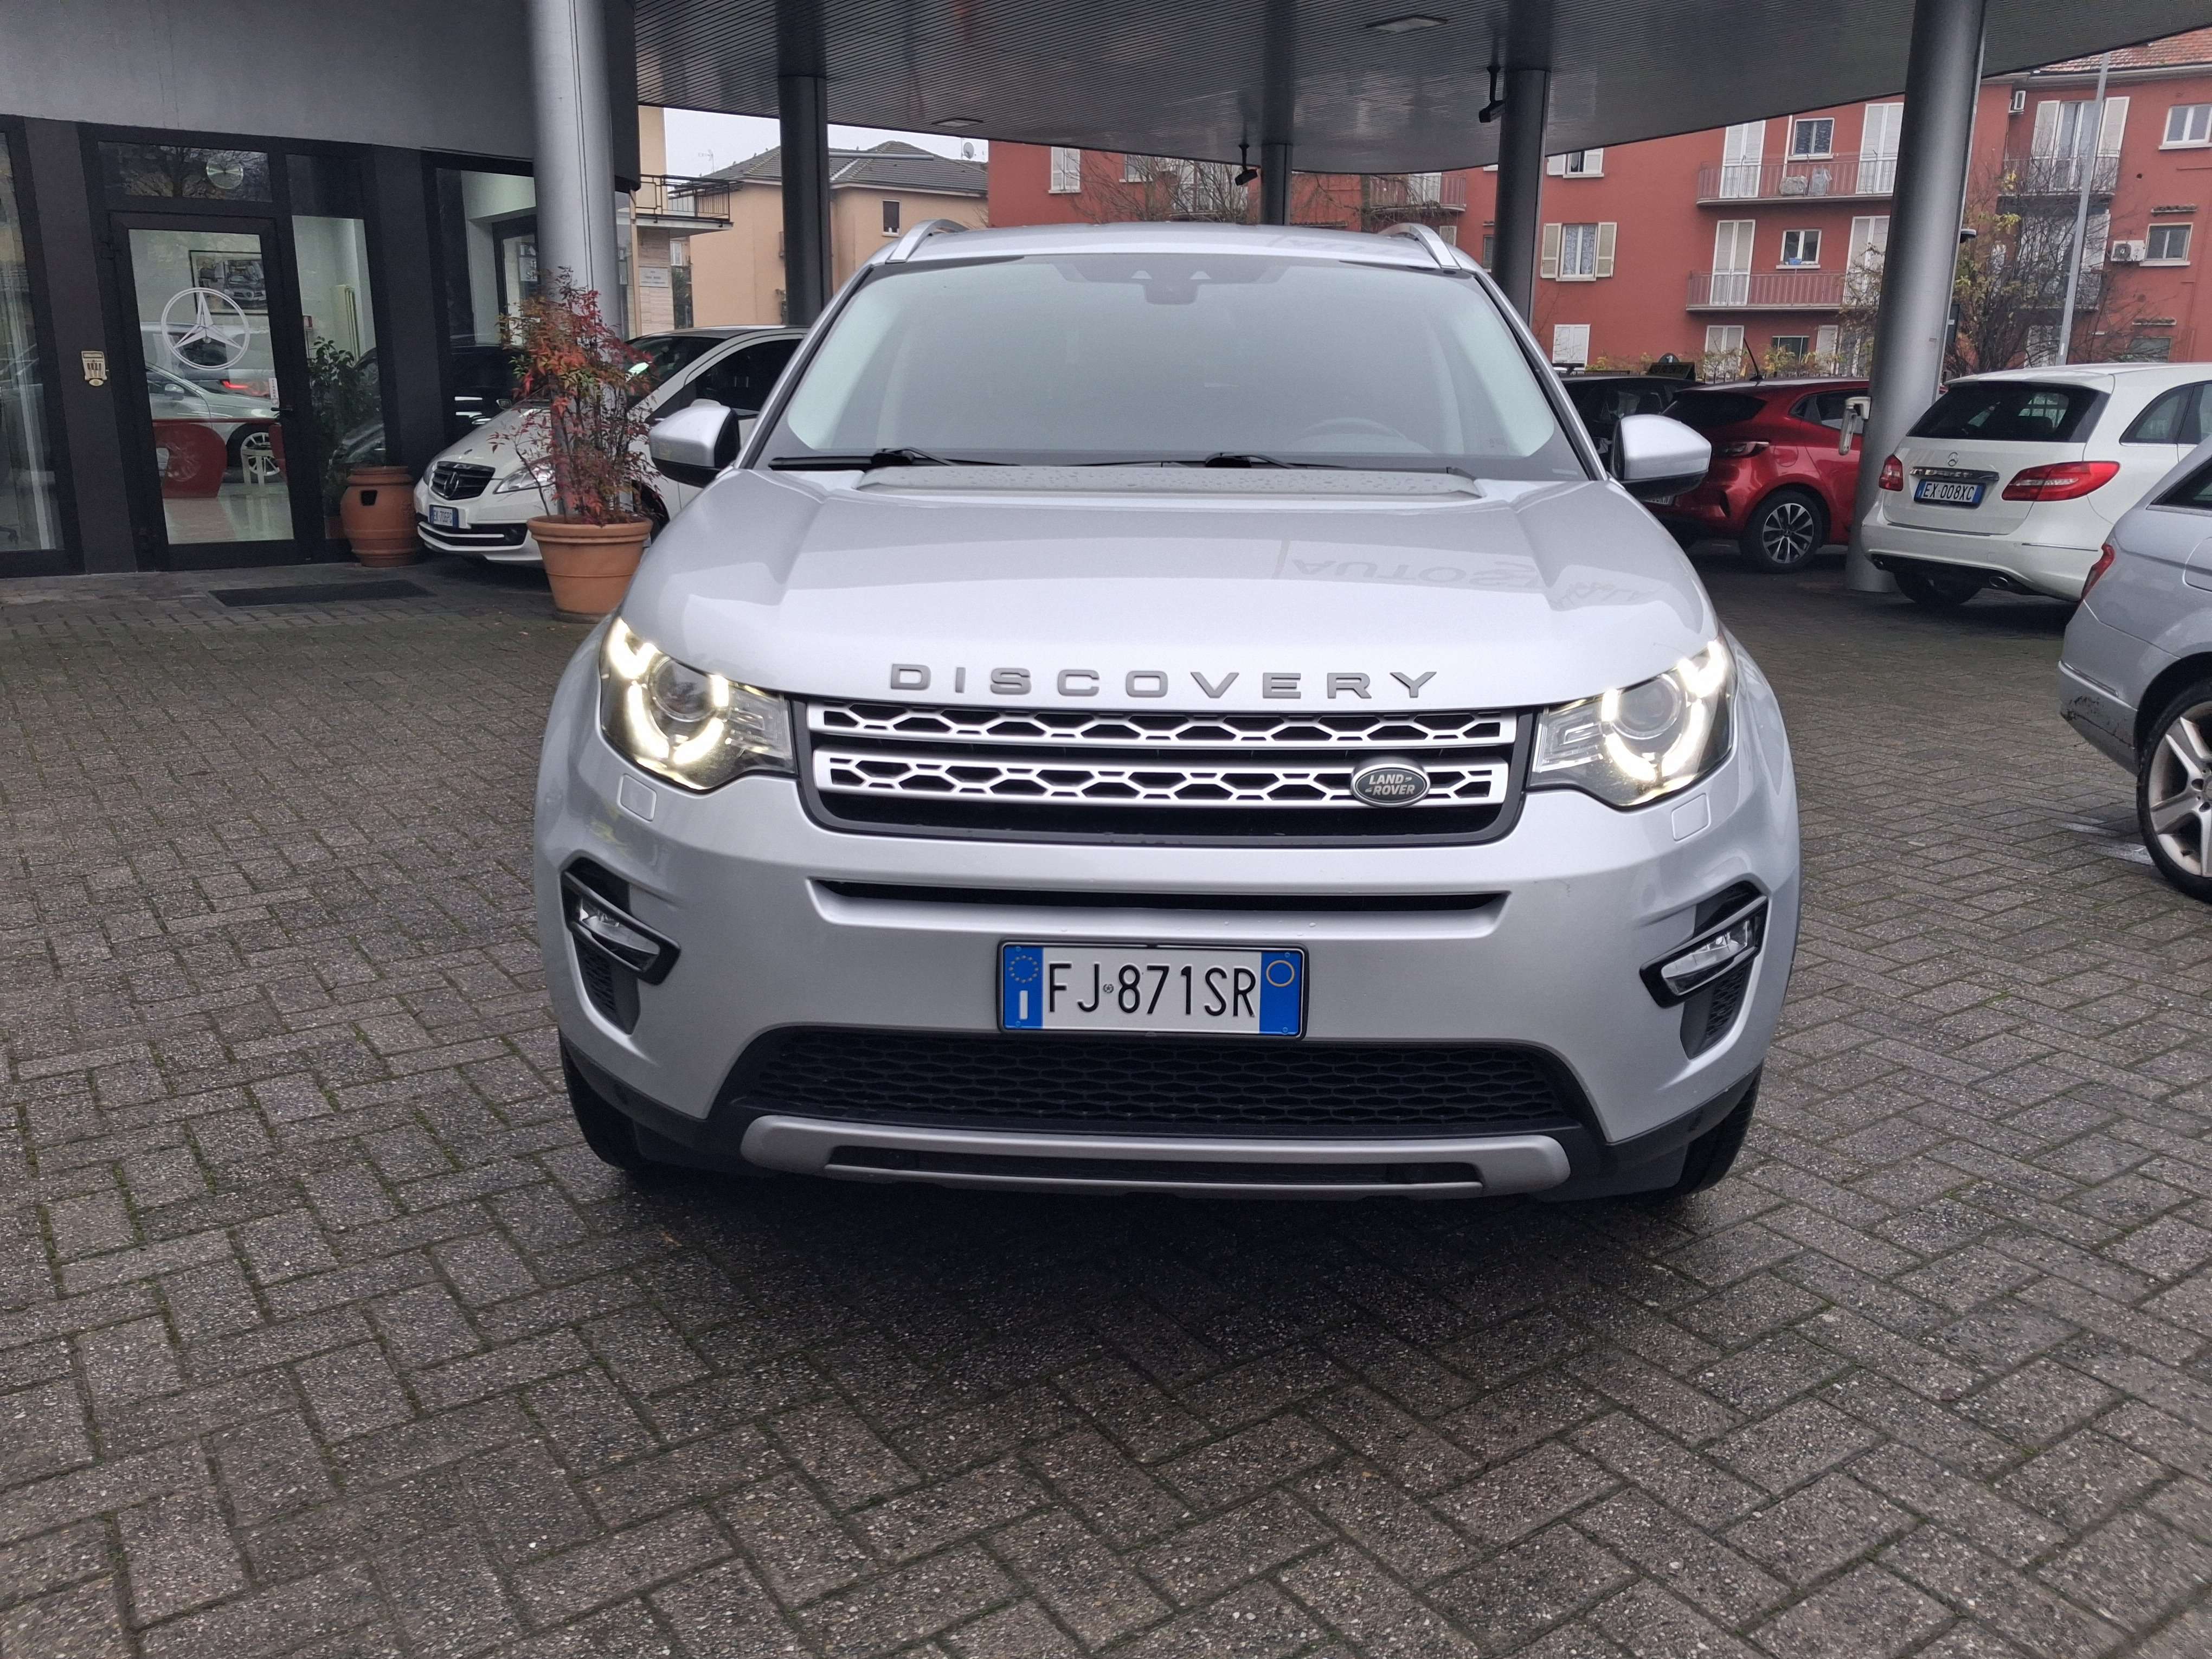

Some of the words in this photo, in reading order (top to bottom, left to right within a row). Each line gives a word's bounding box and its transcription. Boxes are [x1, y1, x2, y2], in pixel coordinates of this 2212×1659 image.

[890, 663, 1437, 699] DISCOVERY
[1369, 774, 1404, 785] LAND
[1373, 785, 1415, 796] ROVER
